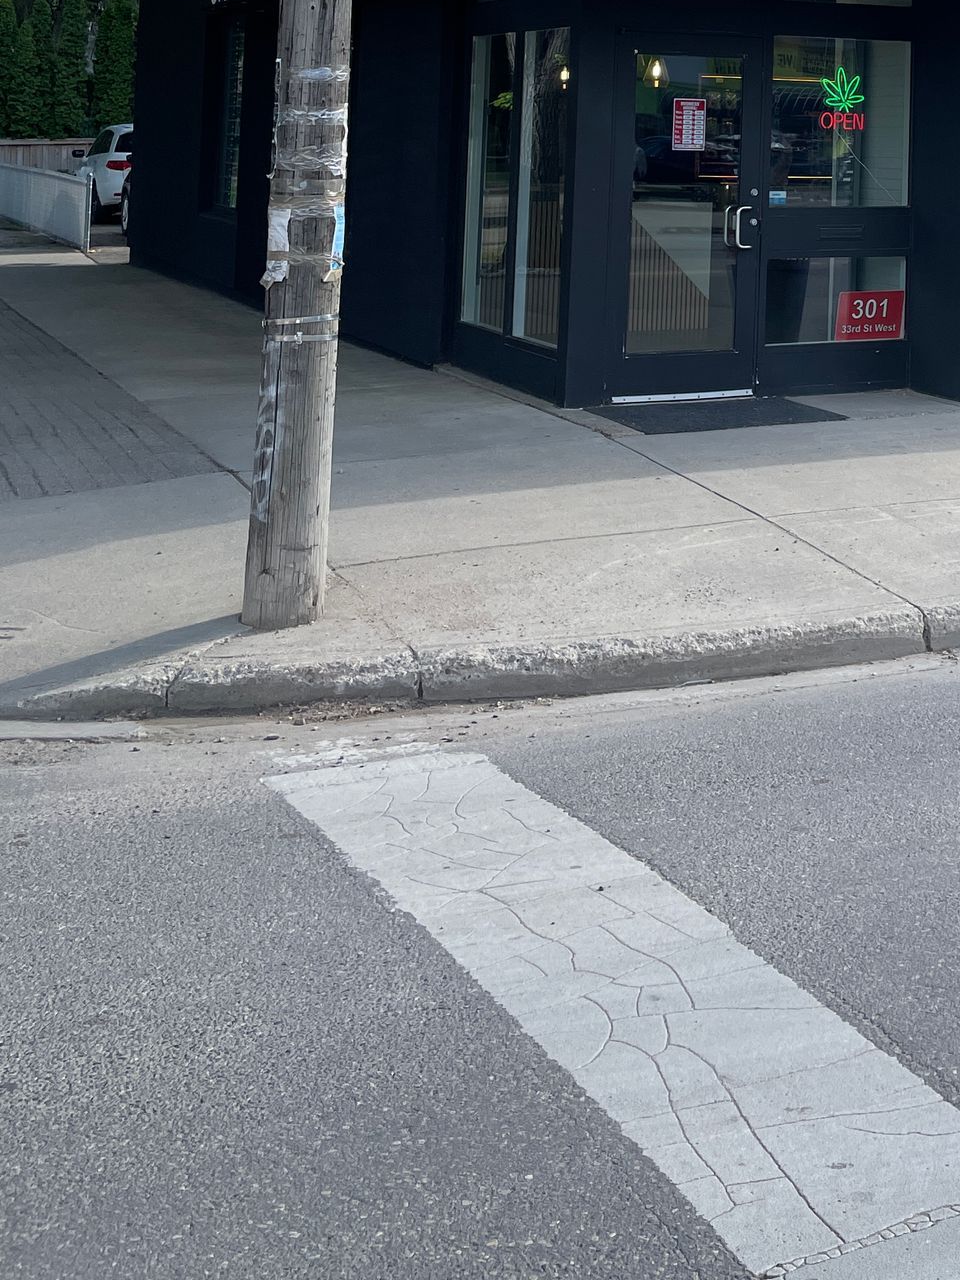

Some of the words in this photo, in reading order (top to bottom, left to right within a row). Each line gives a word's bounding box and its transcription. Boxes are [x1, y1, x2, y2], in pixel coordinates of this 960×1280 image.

[820, 111, 864, 130] OPEN
[851, 298, 888, 319] 301
[841, 324, 861, 334] 33rd
[863, 323, 872, 333] St
[875, 323, 896, 332] West
